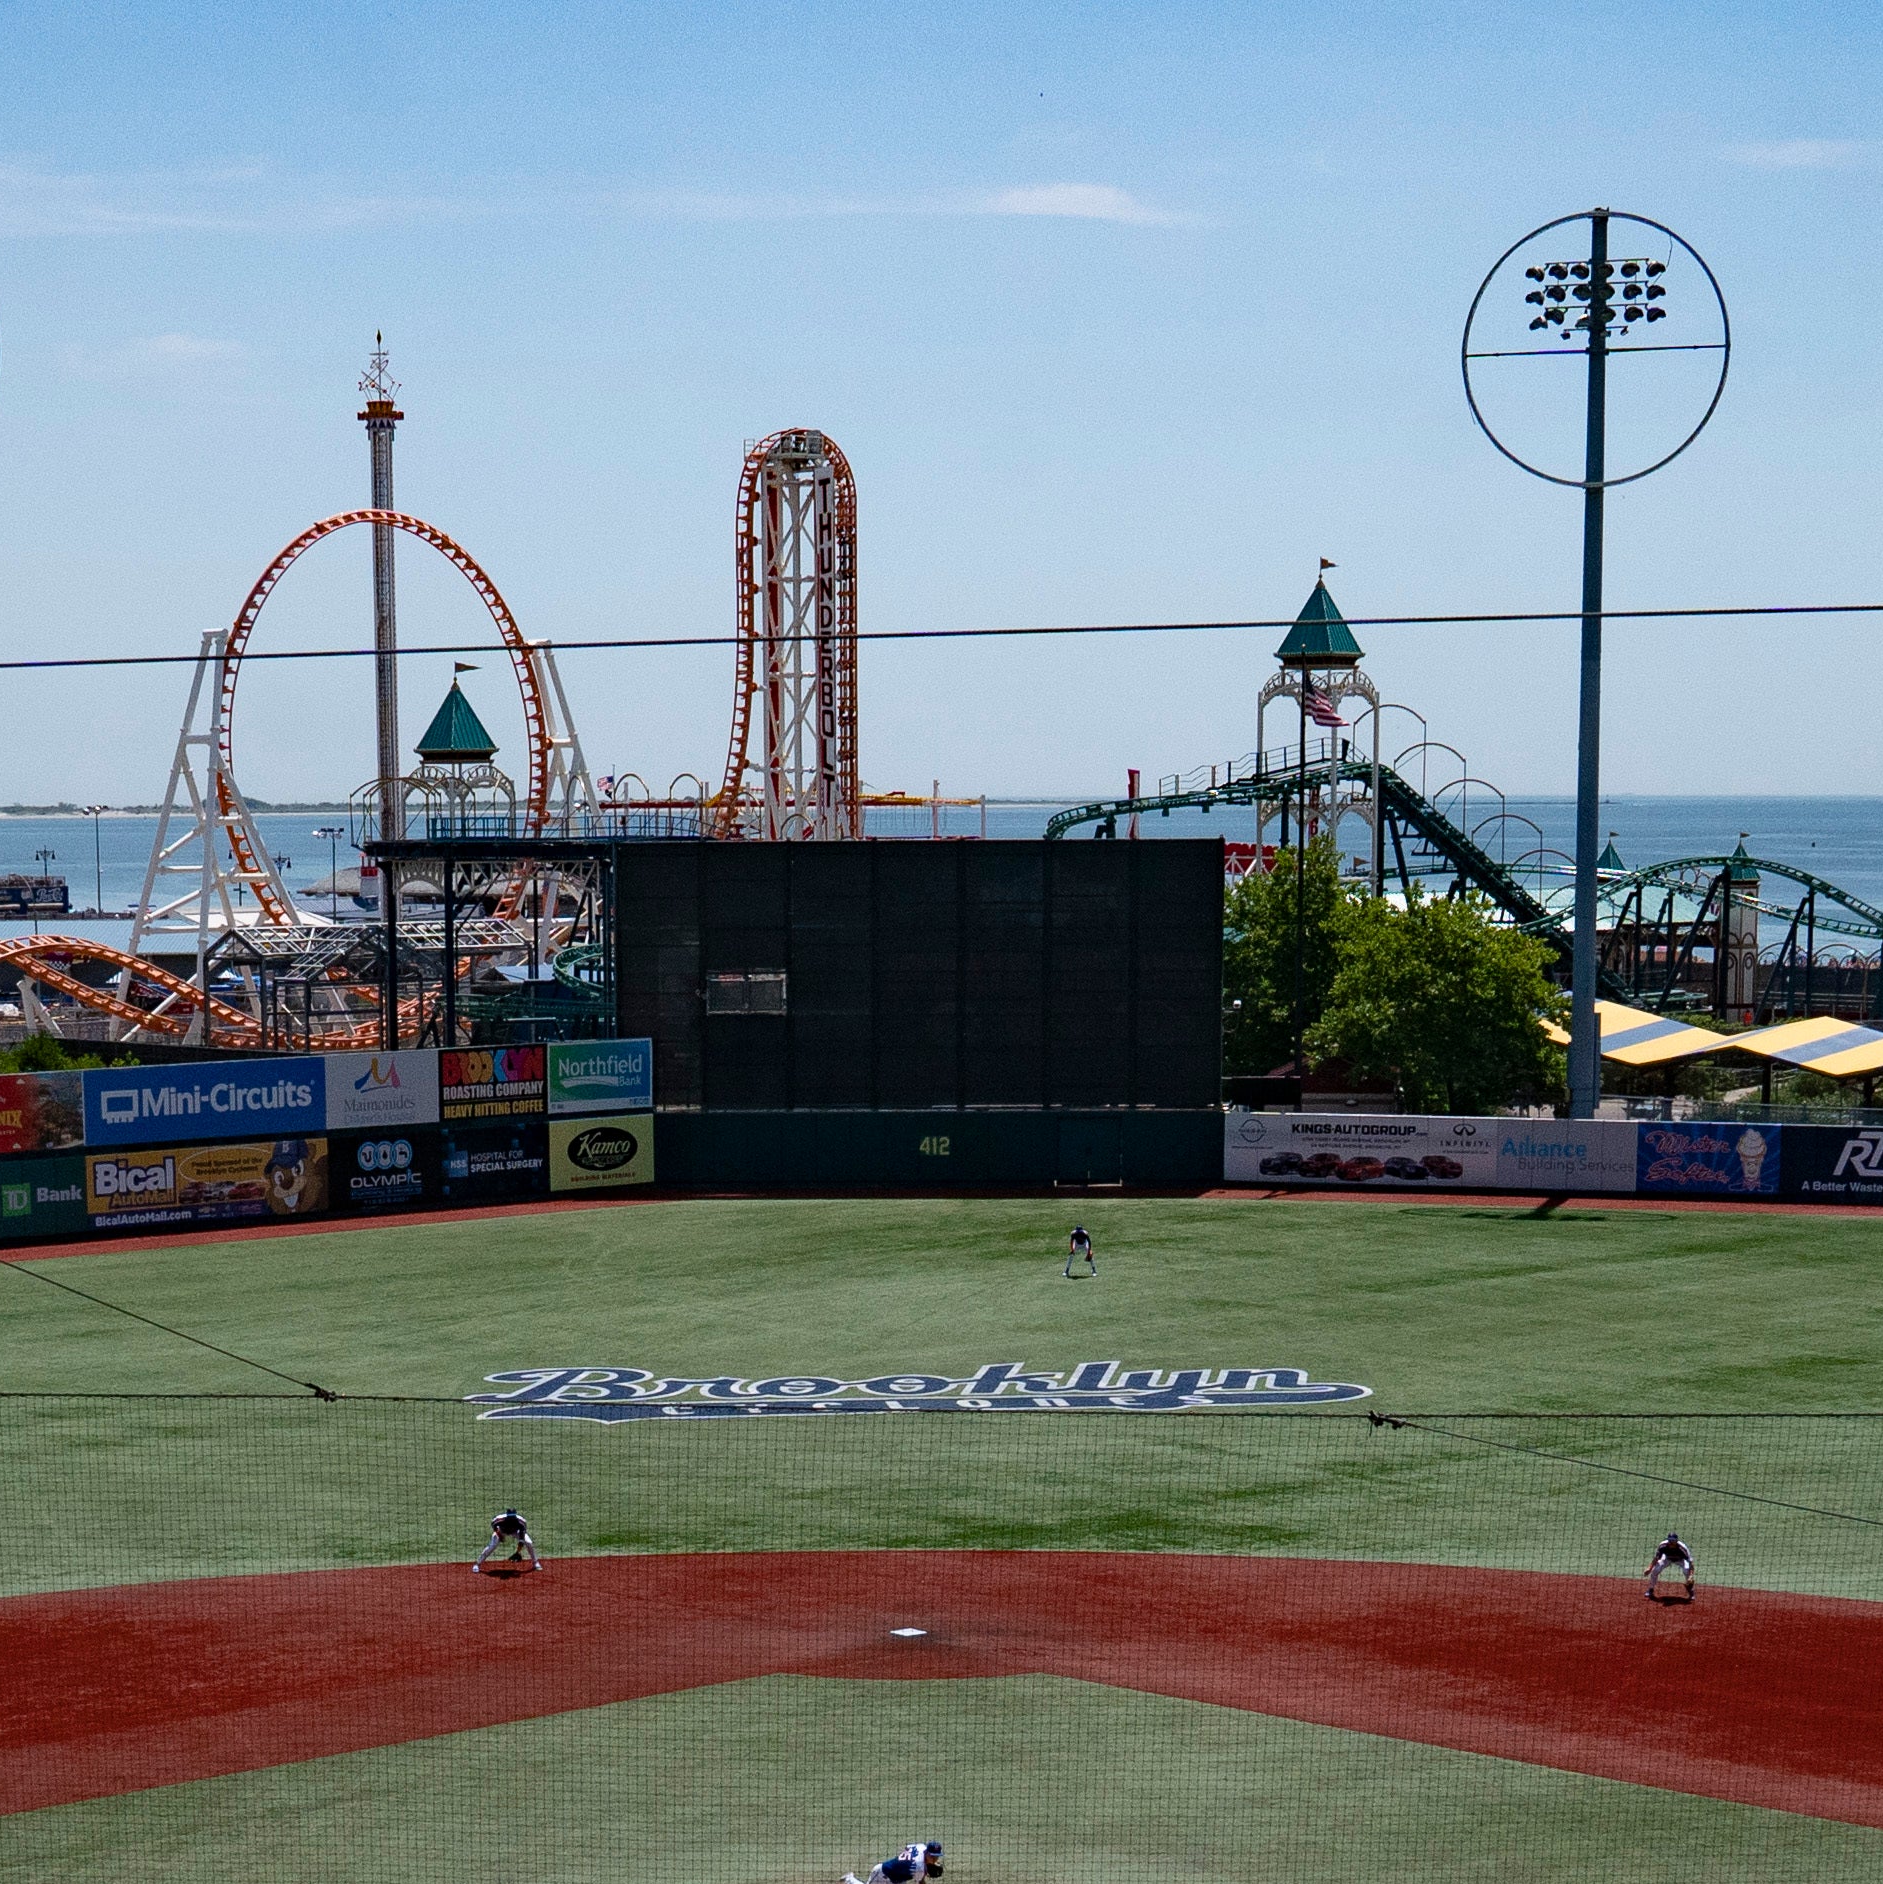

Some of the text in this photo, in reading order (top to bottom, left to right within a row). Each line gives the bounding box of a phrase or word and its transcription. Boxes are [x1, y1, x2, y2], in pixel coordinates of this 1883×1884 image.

[442, 1050, 546, 1085] BROOKLYN
[558, 1055, 643, 1078] Northfield
[443, 1081, 544, 1099] ROASTING COMPANY
[619, 1076, 643, 1087] Bank
[142, 1080, 313, 1117] Mini-Circuits
[344, 1095, 415, 1112] Maimonides
[444, 1099, 544, 1118] HEAVY HITTING COFFEE
[578, 1132, 630, 1156] Kamco
[919, 1136, 950, 1155] 412
[470, 1150, 505, 1162] HOSPITAL
[508, 1150, 523, 1160] FOR
[1519, 1157, 1634, 1174] Building Services
[470, 1159, 543, 1173] SPECIAL SURGERY
[94, 1157, 174, 1196] Bical
[350, 1171, 423, 1188] OLYMPIC
[1801, 1181, 1809, 1190] A
[1812, 1181, 1846, 1192] Better
[1848, 1182, 1883, 1193] Waste
[4, 1184, 81, 1212] TD Bank
[95, 1208, 192, 1228] BicalAutoMall.com
[482, 1360, 1308, 1402] Brooklyn
